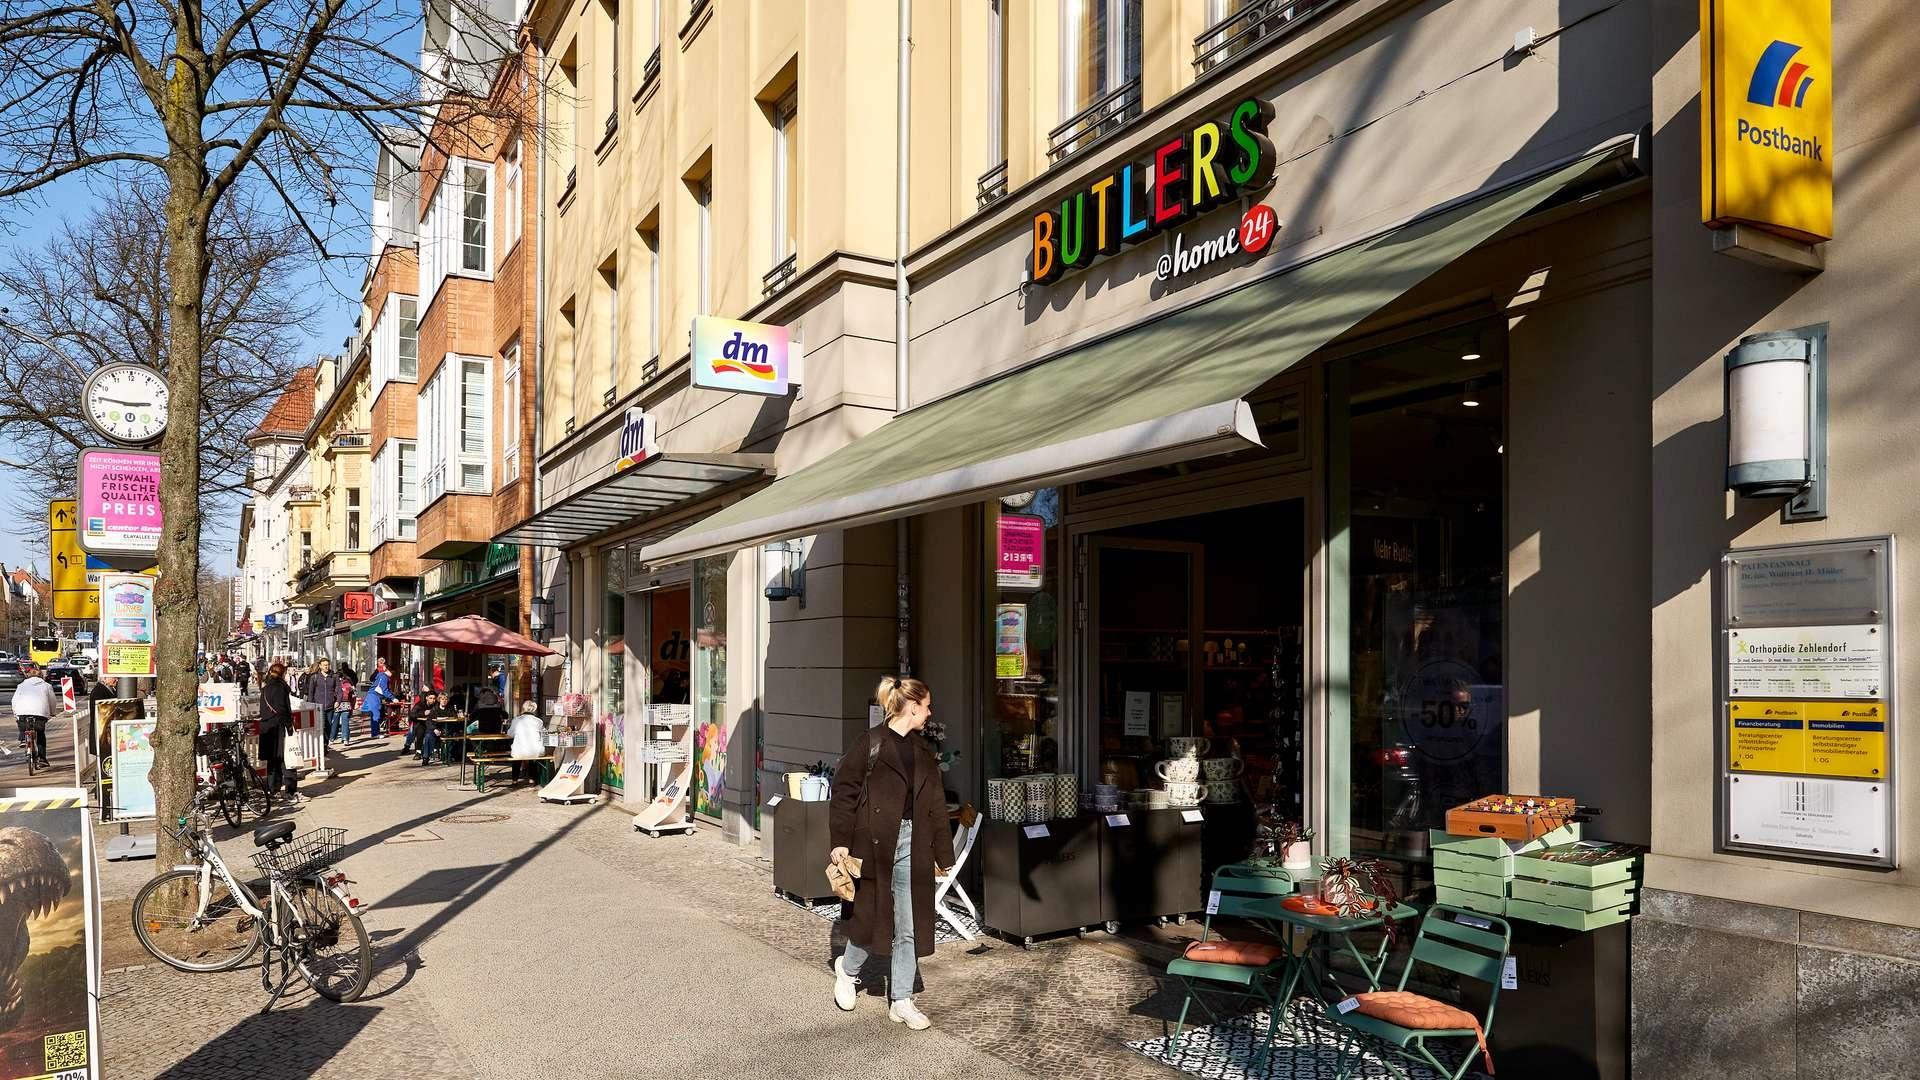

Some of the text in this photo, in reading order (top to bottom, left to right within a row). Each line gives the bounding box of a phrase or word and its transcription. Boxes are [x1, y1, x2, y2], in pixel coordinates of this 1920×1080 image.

[1737, 118, 1822, 161] Postbank
[1034, 100, 1261, 281] BUTLERS
[723, 331, 768, 364] dm
[622, 412, 644, 458] dm
[102, 473, 155, 483] AUSWAHL
[102, 482, 156, 493] FRISCHE
[102, 492, 156, 502] QUALITÄT
[102, 502, 156, 516] PREIS
[1750, 642, 1847, 655] Orthopädie Zehlendorf
[567, 760, 583, 774] dm
[666, 780, 679, 798] dm
